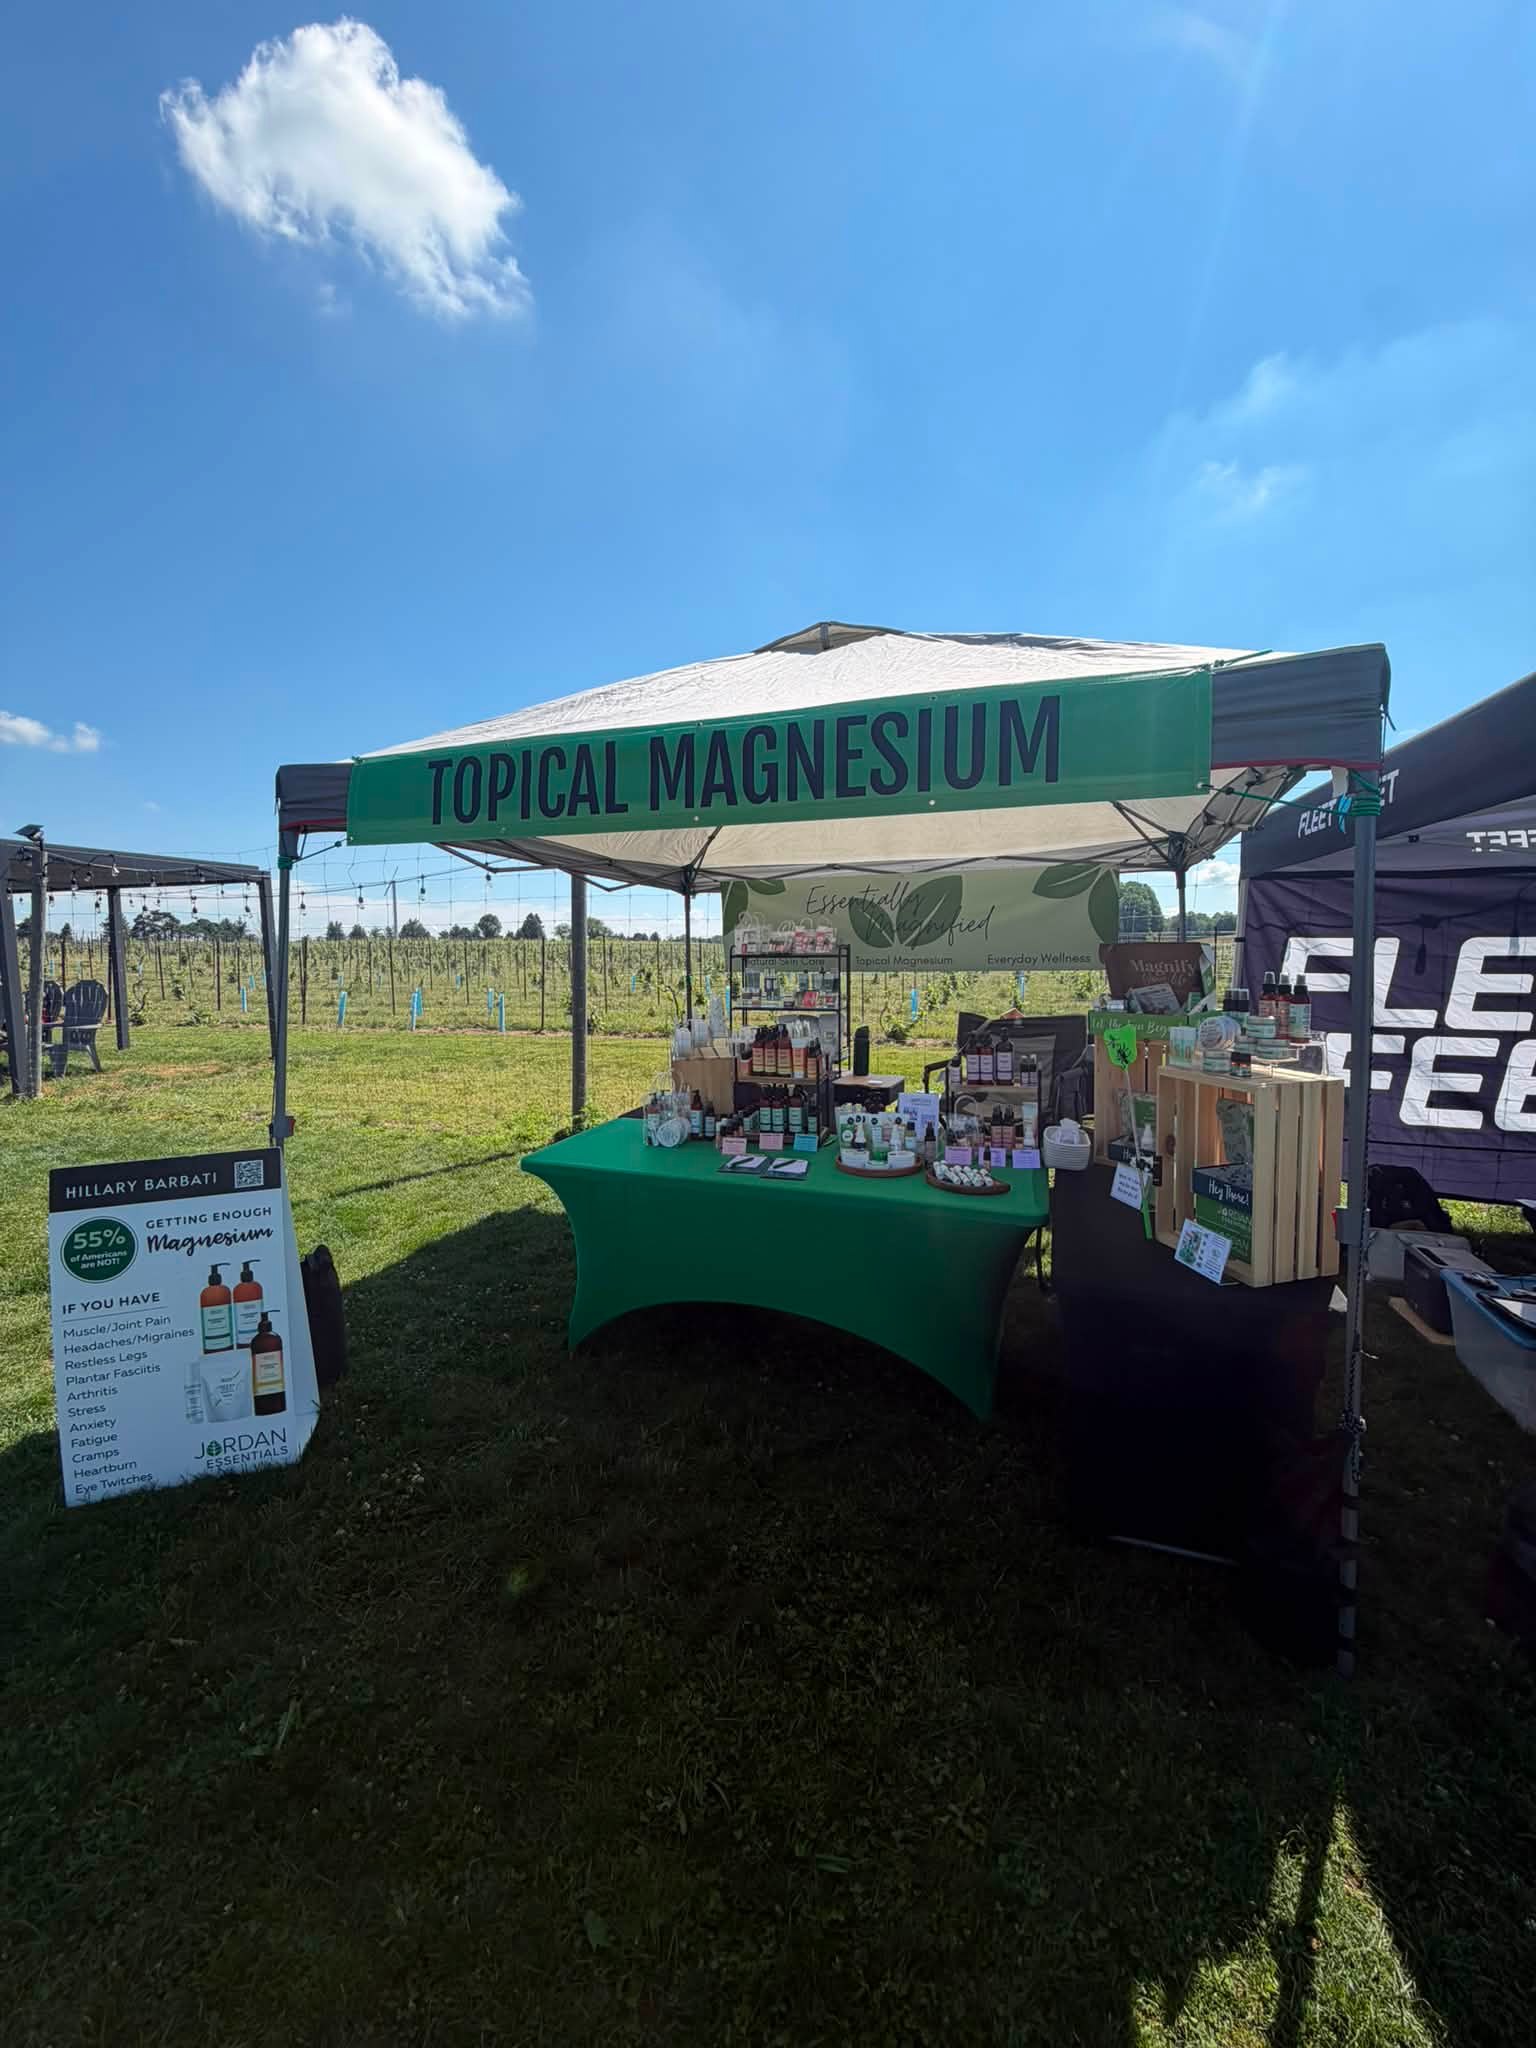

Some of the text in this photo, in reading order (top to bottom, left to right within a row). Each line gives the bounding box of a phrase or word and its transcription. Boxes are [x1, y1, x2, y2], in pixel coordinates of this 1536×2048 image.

[428, 695, 1060, 825] TOPICAL MAGNESIUM
[1298, 798, 1337, 838] FLEET
[806, 882, 923, 916] Essentially
[866, 905, 995, 950] Magnified
[743, 956, 777, 967] atural
[856, 956, 953, 967] Topical Magnesium
[987, 952, 1091, 966] Everyday Wellness
[66, 1172, 217, 1199] HILLARY BARBATI
[146, 1207, 272, 1229] GETTING ENOUGH
[73, 1226, 126, 1249] 55%
[147, 1227, 274, 1256] Magnesium
[70, 1250, 128, 1263] of Americans
[62, 1292, 161, 1315] IF YOU HAVE
[63, 1315, 171, 1339] Muscle/Joint Pain
[64, 1328, 195, 1355] Headaches/Migraines
[65, 1351, 148, 1370] Restless Legs
[66, 1371, 110, 1386] Plantar
[67, 1386, 118, 1402] Arthritis
[68, 1404, 106, 1418] Stress
[69, 1418, 116, 1433] Anxiety
[71, 1433, 118, 1449] Fatigue
[194, 1427, 287, 1460] JORDAN
[72, 1448, 120, 1463] Cramps
[206, 1446, 289, 1469] ESSENTIALS
[74, 1460, 137, 1479] Heartburn
[75, 1472, 153, 1497] Eye Twitches
